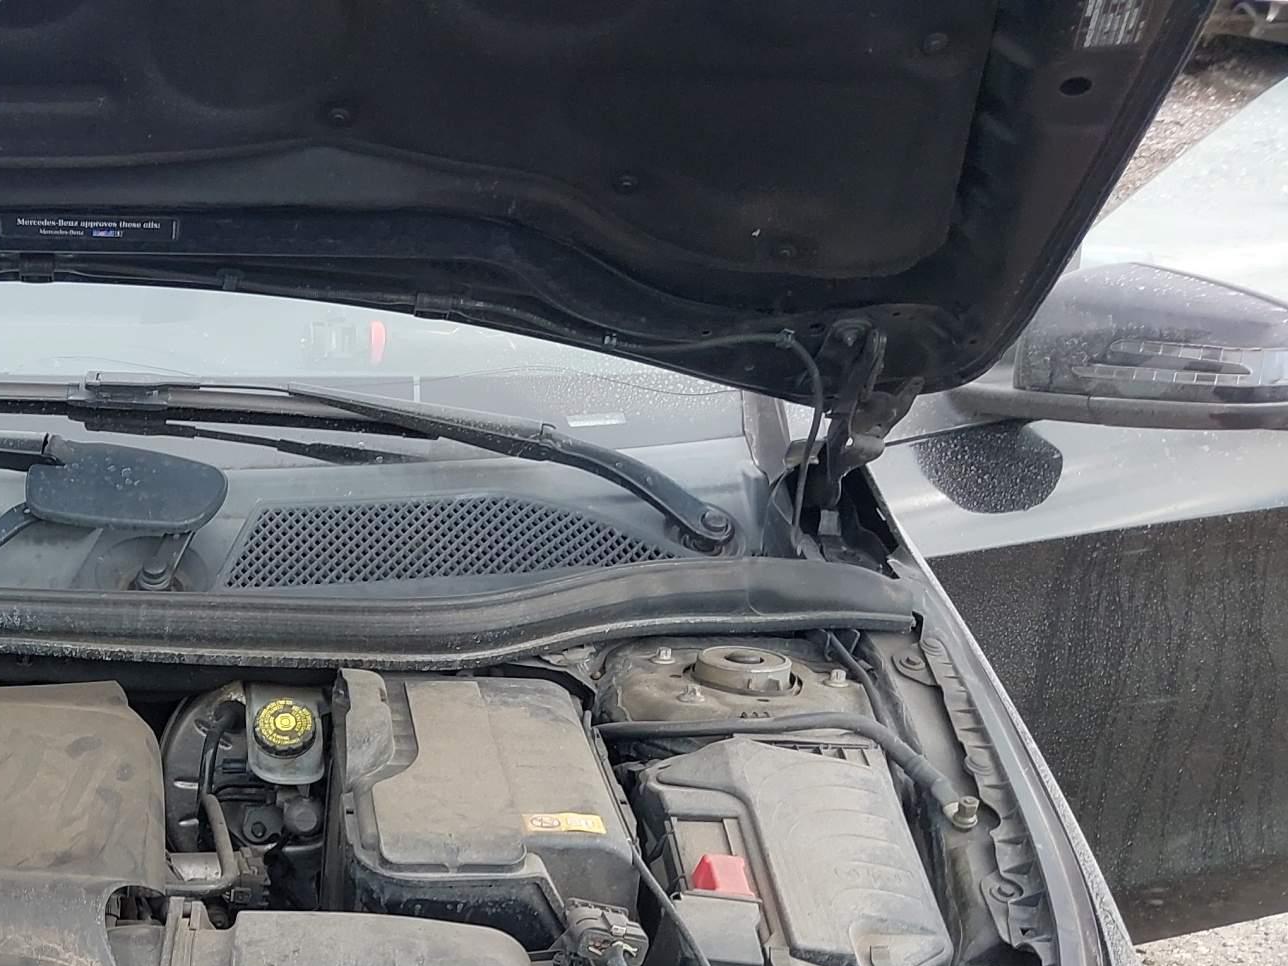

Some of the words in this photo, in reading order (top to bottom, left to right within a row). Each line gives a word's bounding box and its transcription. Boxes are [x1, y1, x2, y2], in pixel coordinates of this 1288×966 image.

[17, 217, 79, 228] Mercedes-Benz
[80, 220, 118, 229] approves
[119, 221, 142, 229] these
